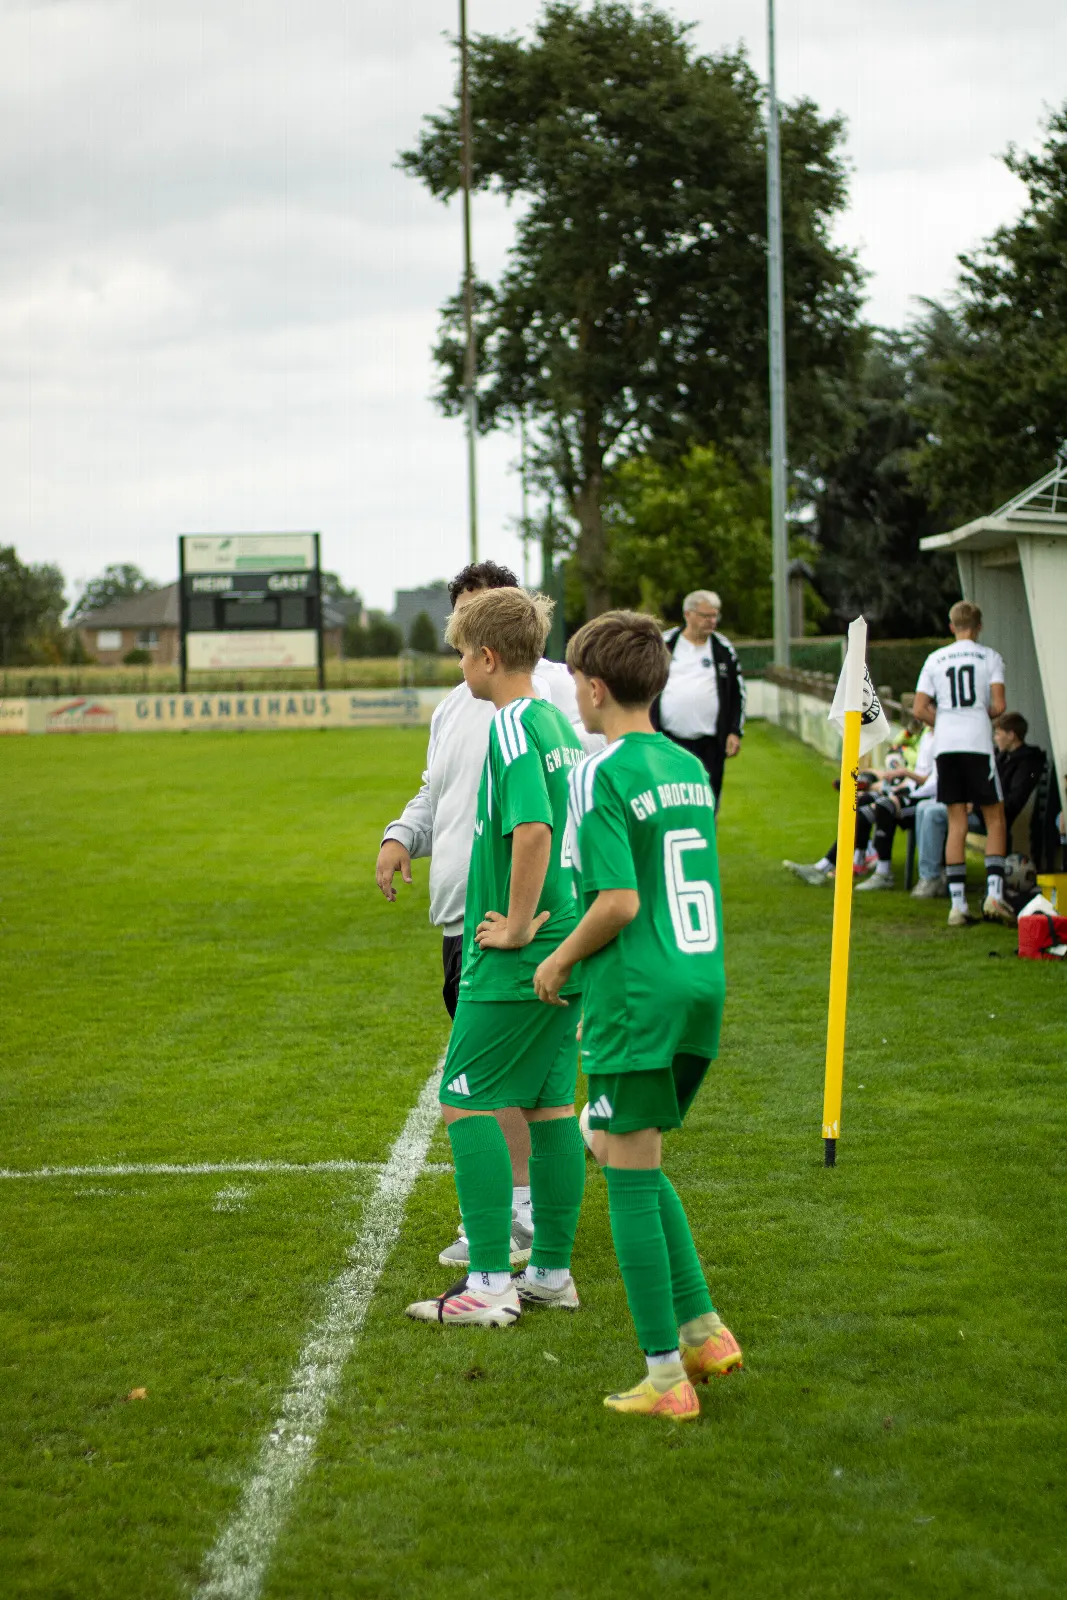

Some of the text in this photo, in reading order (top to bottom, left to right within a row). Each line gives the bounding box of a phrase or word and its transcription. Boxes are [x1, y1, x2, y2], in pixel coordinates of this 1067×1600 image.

[192, 577, 233, 592] HEIM
[267, 573, 309, 591] GAST
[945, 664, 976, 708] 10
[545, 747, 561, 772] GW
[630, 789, 657, 820] GW
[663, 828, 717, 954] 6
